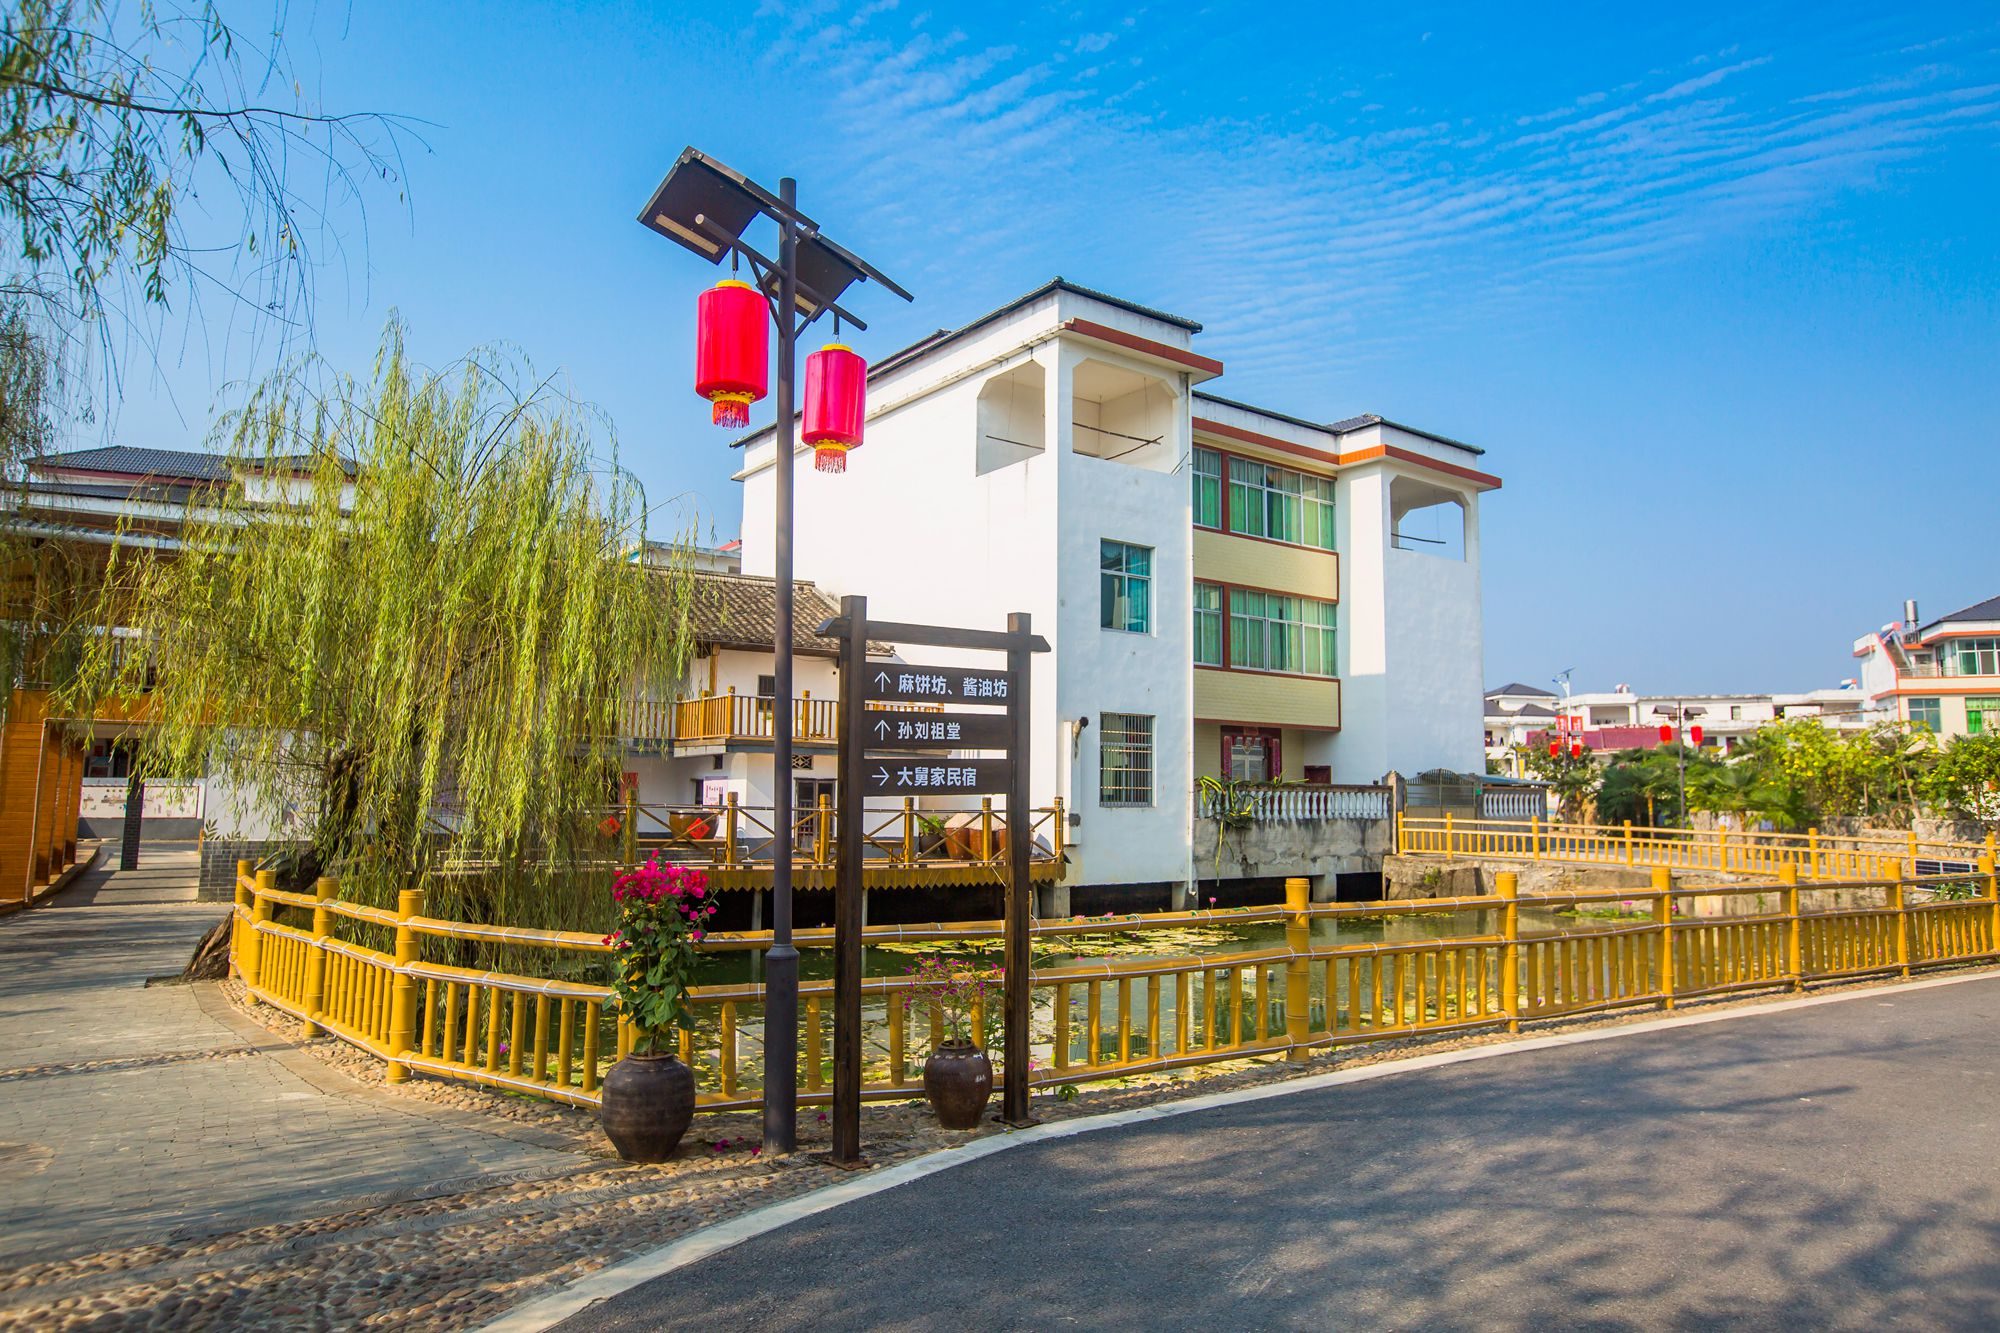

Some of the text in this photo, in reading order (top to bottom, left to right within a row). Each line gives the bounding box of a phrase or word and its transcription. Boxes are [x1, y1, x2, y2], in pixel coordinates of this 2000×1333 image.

[898, 673, 1008, 698] 麻饼坊、酱油坊
[897, 721, 961, 740] 孙刘祖堂
[896, 766, 977, 787] 大舅家民宿
